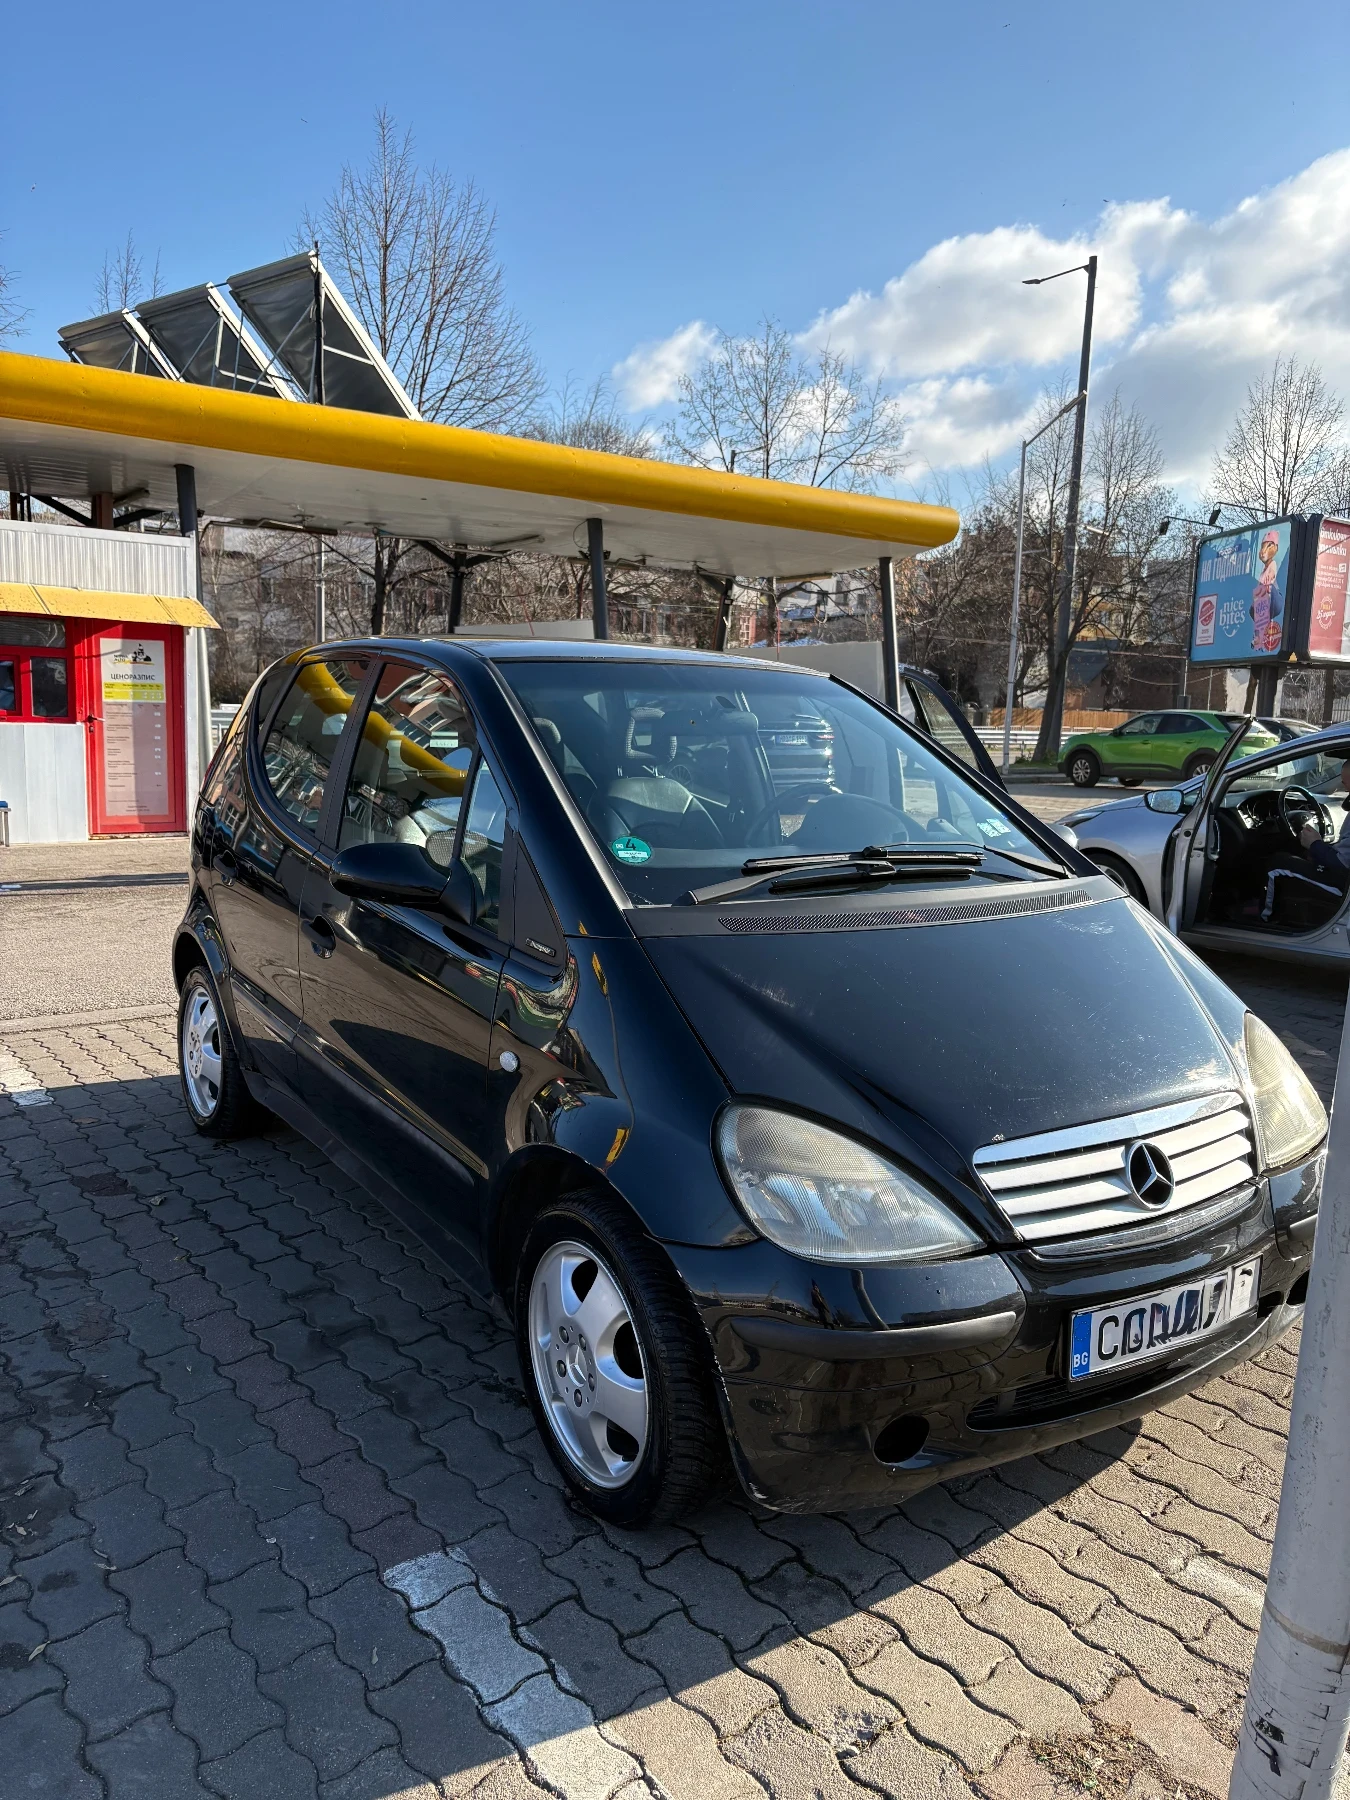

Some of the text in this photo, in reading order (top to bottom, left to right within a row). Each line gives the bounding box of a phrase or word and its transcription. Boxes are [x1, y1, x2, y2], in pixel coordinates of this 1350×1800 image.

[1201, 559, 1212, 583] НА
[1223, 597, 1245, 613] nice
[1219, 609, 1246, 626] bites
[110, 673, 156, 681] ЦЕНОРАЗПИС
[625, 838, 637, 850] 4
[1072, 1351, 1089, 1369] BG
